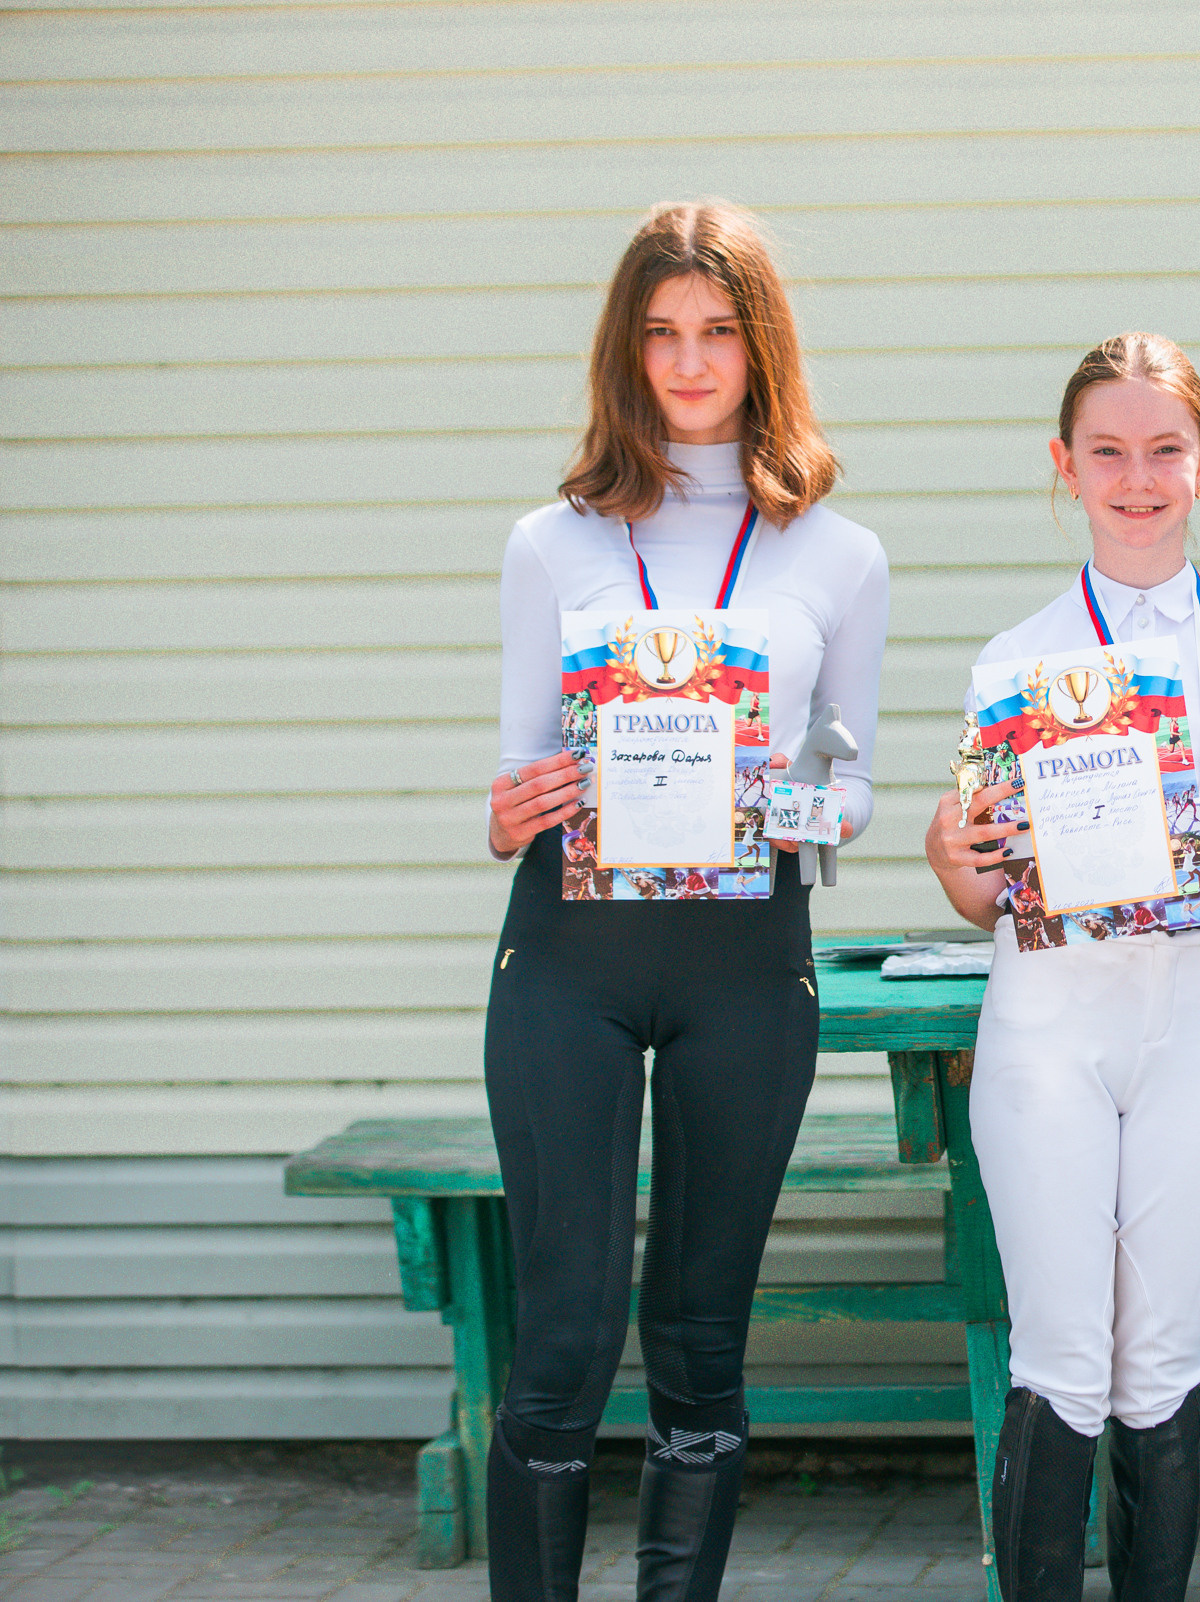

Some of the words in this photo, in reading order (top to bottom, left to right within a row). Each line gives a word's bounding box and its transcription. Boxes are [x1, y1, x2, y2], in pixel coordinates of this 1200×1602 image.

[613, 714, 719, 733] ГРАМОТА
[610, 749, 666, 763] Захарова
[671, 748, 712, 767] Дарья
[1036, 746, 1143, 779] ГРАМОТА
[652, 775, 669, 787] II
